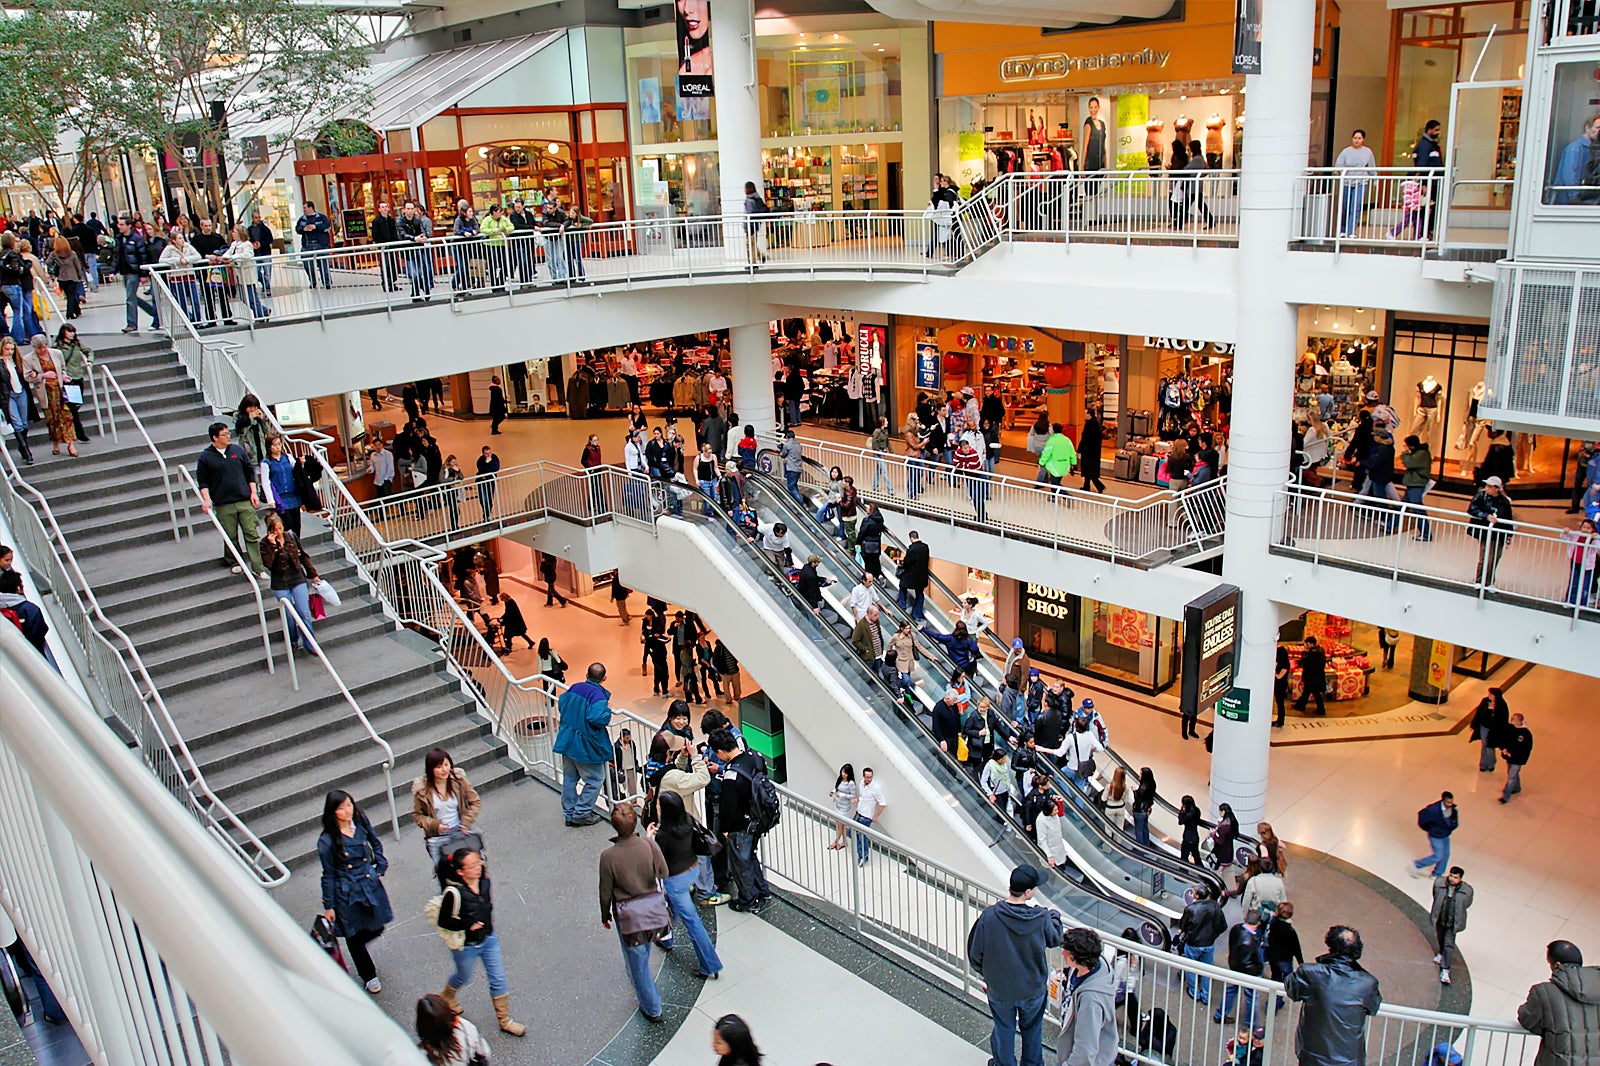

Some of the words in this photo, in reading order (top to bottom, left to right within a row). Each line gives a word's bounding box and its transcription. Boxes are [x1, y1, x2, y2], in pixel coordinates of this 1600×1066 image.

[1005, 59, 1064, 78] thyme
[1067, 48, 1171, 70] maternity
[957, 332, 1035, 353] GYMBOREE
[1027, 582, 1068, 603] BODY
[1027, 598, 1068, 619] SHOP
[1203, 623, 1234, 652] ENDLESS
[1333, 717, 1380, 728] BODY
